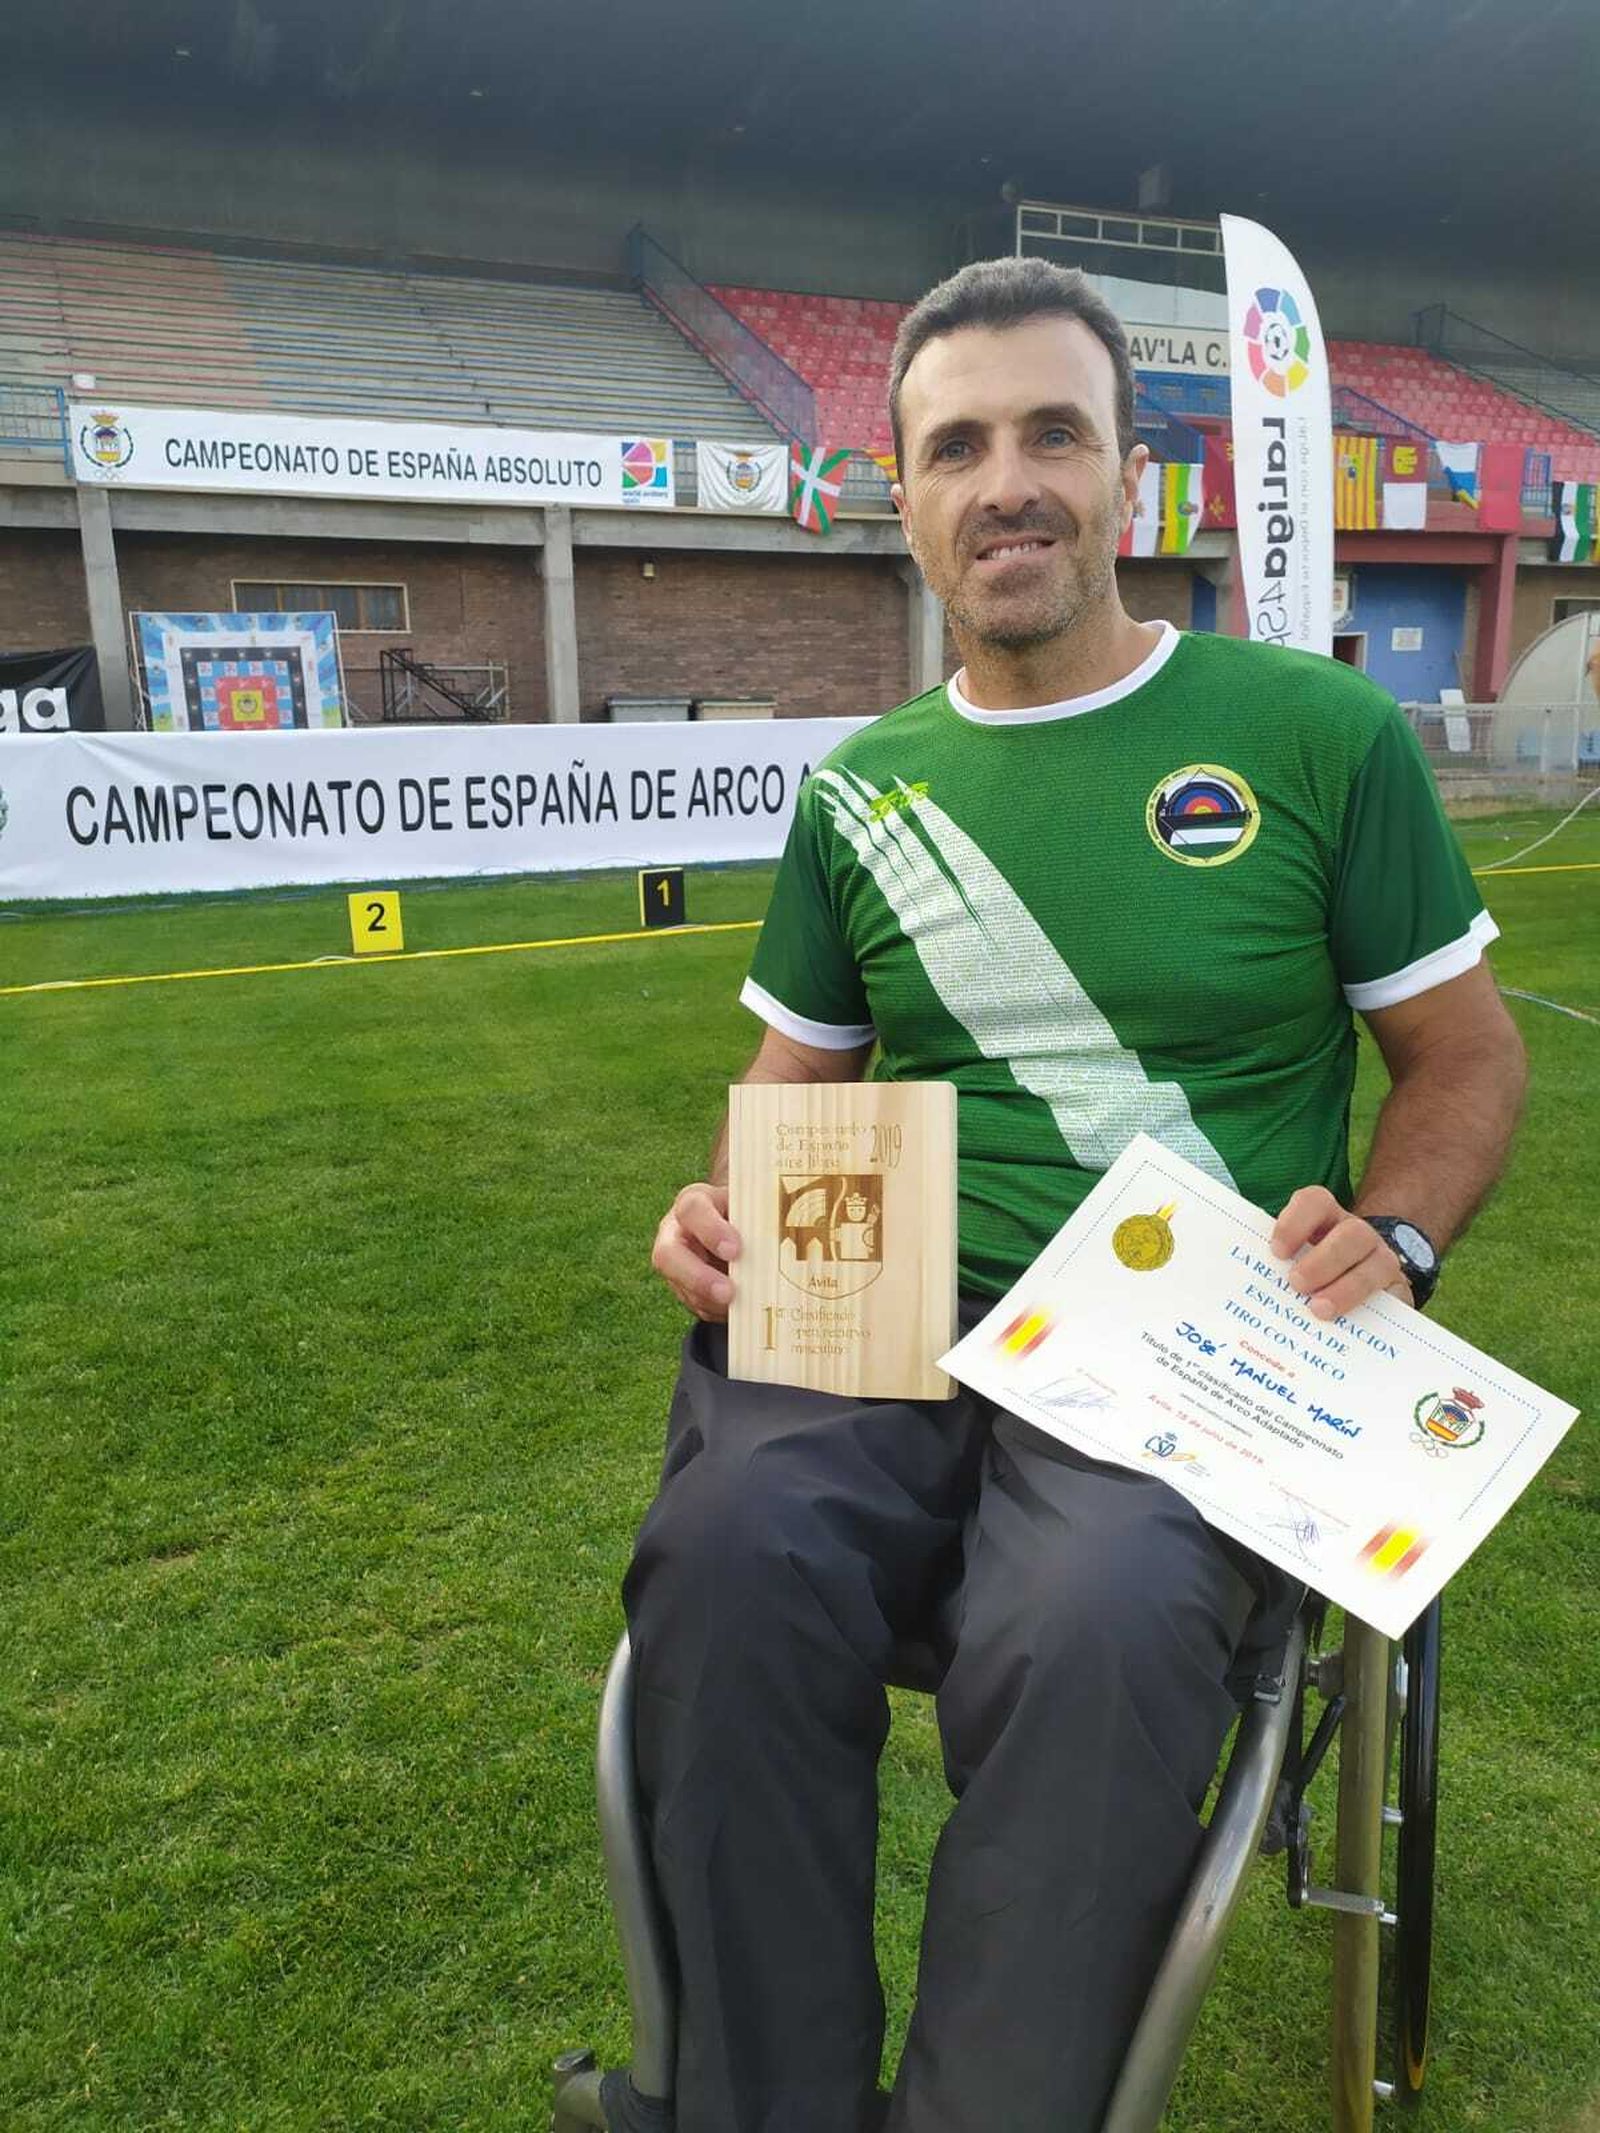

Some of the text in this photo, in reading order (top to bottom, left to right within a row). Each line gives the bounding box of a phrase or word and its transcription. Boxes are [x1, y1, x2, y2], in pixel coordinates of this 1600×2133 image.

[1130, 336, 1196, 366] AVLA
[166, 439, 601, 487] CAMPEONATO DE ESPAÑA ABSOLUTO
[66, 779, 384, 845] CAMPEONATO
[399, 777, 452, 831] DE
[466, 760, 618, 829] ESPAÑA
[631, 769, 676, 820] DE
[688, 765, 784, 817] ARCO
[367, 903, 386, 931] 2
[657, 880, 669, 907] 1
[1230, 1245, 1250, 1266] LA
[1225, 1300, 1345, 1380] TIRO CON ARCO
[1245, 1284, 1345, 1357] ESPAÑOLA DE
[1155, 1356, 1170, 1367] de
[1209, 1389, 1225, 1400] de
[1224, 1397, 1251, 1417] Arco
[1169, 1351, 1183, 1363] de
[1254, 1404, 1274, 1418] del
[1229, 1358, 1296, 1404] MANUEL
[1307, 1404, 1361, 1438] MARÍN
